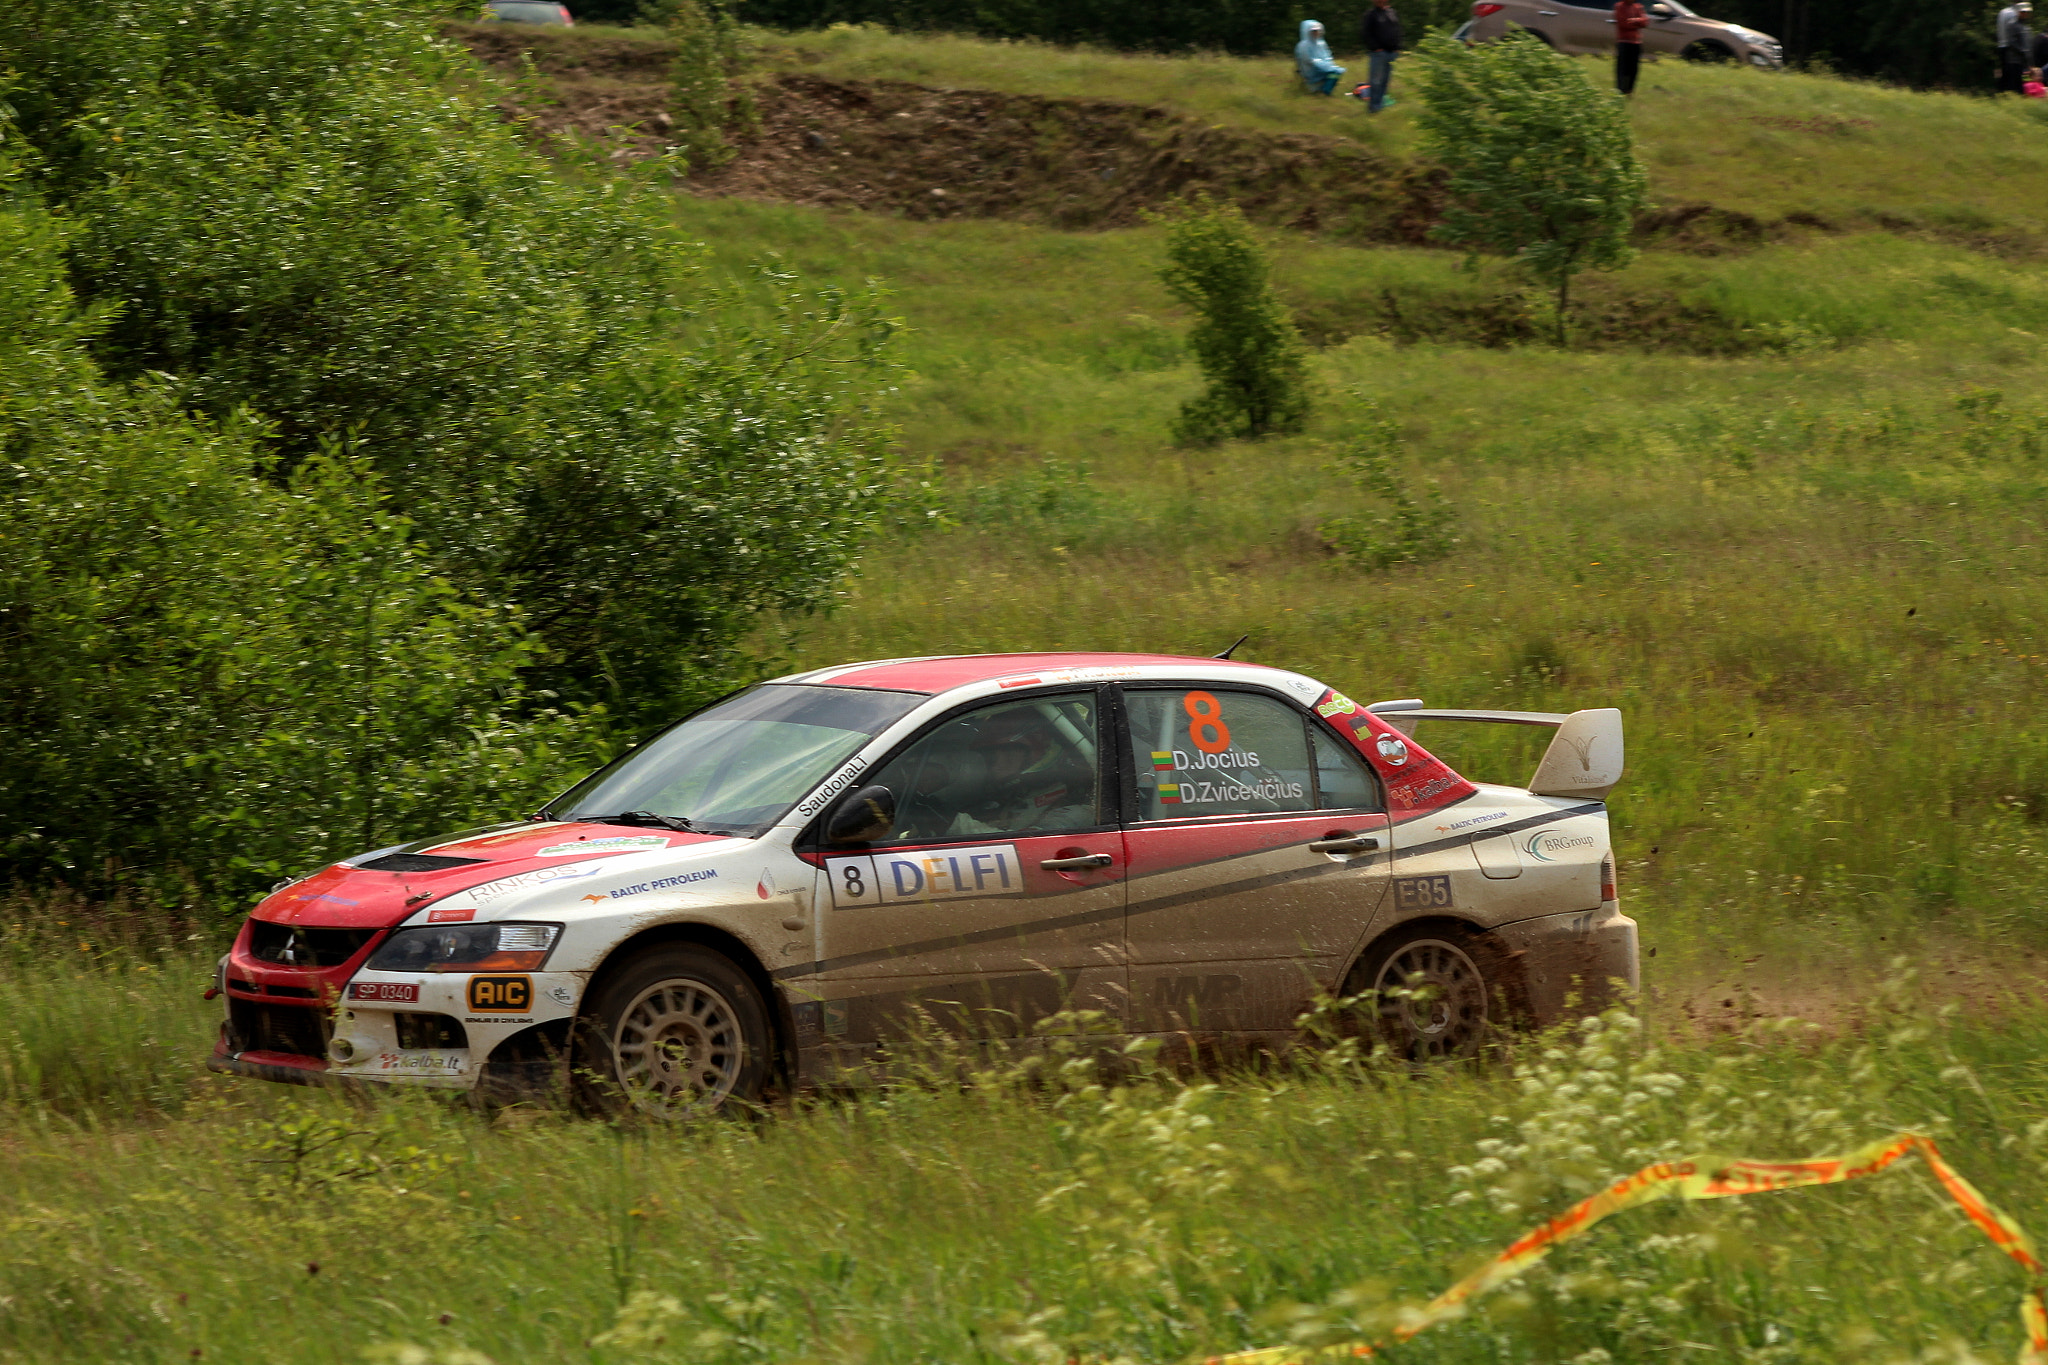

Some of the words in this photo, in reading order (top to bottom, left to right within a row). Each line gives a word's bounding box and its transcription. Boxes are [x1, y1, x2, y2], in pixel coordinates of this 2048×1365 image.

[1184, 691, 1231, 752] 8
[1173, 750, 1260, 771] D.Jocius
[798, 755, 869, 817] SaudonaLT
[1181, 779, 1303, 804] D.Zvicevičius
[1450, 820, 1473, 830] BALTIC
[1473, 811, 1508, 825] PETROLEUM
[468, 866, 577, 900] RINKOS
[610, 882, 649, 899] BALTIC
[651, 868, 718, 890] PETROLEUM
[843, 865, 864, 898] 8
[890, 853, 1011, 897] DELFI
[1400, 878, 1448, 906] E85
[359, 984, 378, 999] SP
[380, 985, 413, 1000] 0340
[475, 983, 525, 1005] AIC
